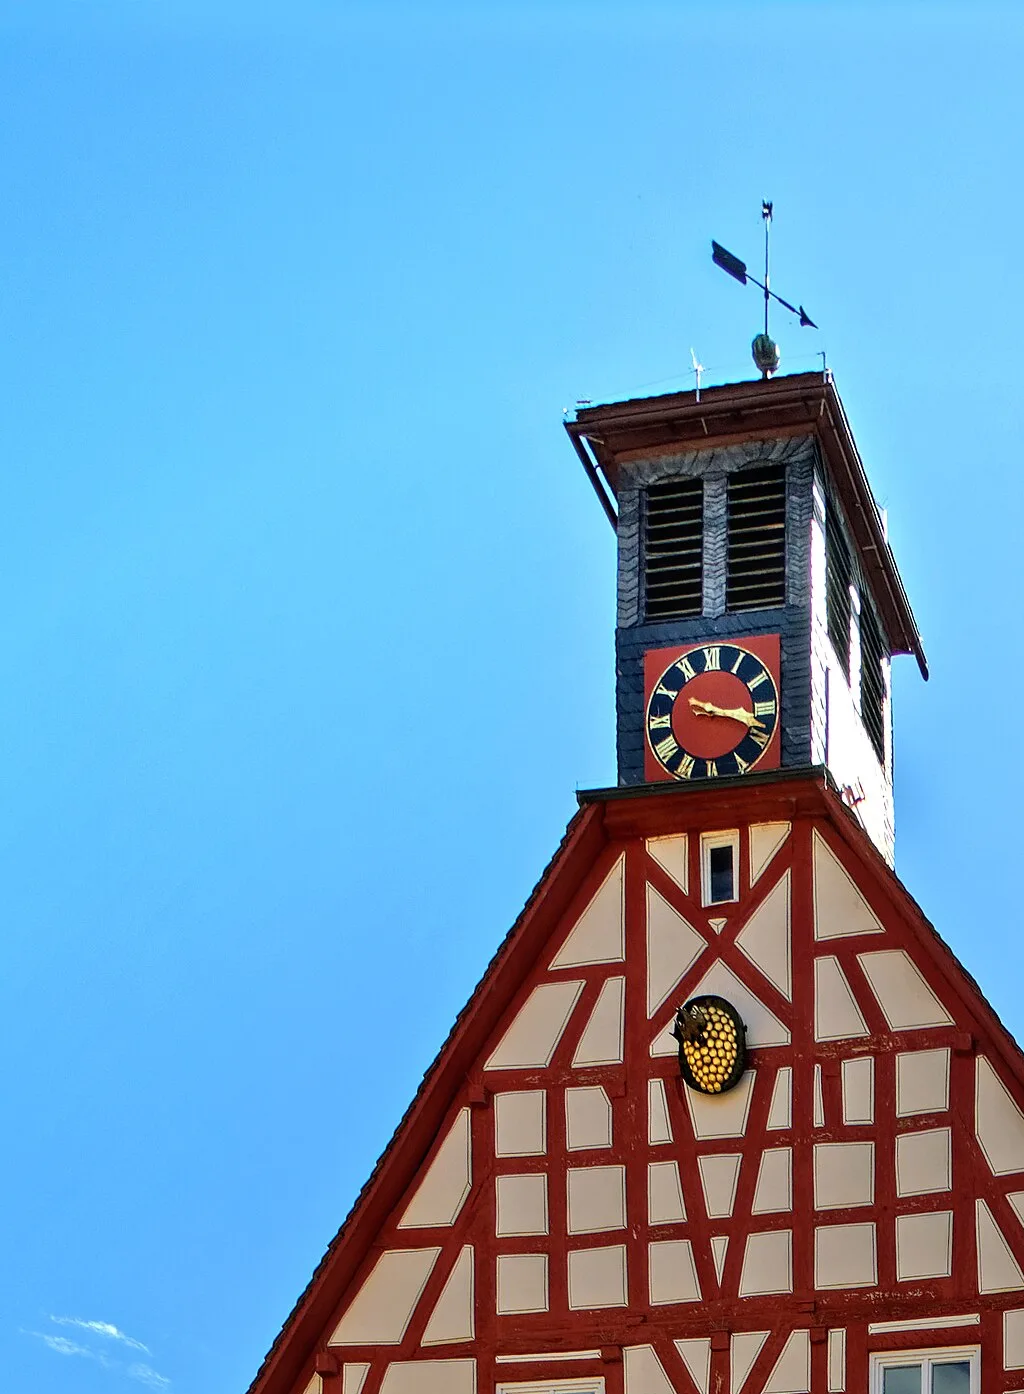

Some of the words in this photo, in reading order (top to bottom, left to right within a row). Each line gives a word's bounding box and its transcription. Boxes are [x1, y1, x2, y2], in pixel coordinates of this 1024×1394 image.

[675, 657, 697, 682] XI
[703, 647, 721, 671] XII
[731, 651, 746, 674] I
[656, 683, 678, 700] X
[747, 670, 768, 692] II
[754, 700, 775, 717] III
[650, 714, 670, 730] IX
[655, 734, 679, 764] VIII
